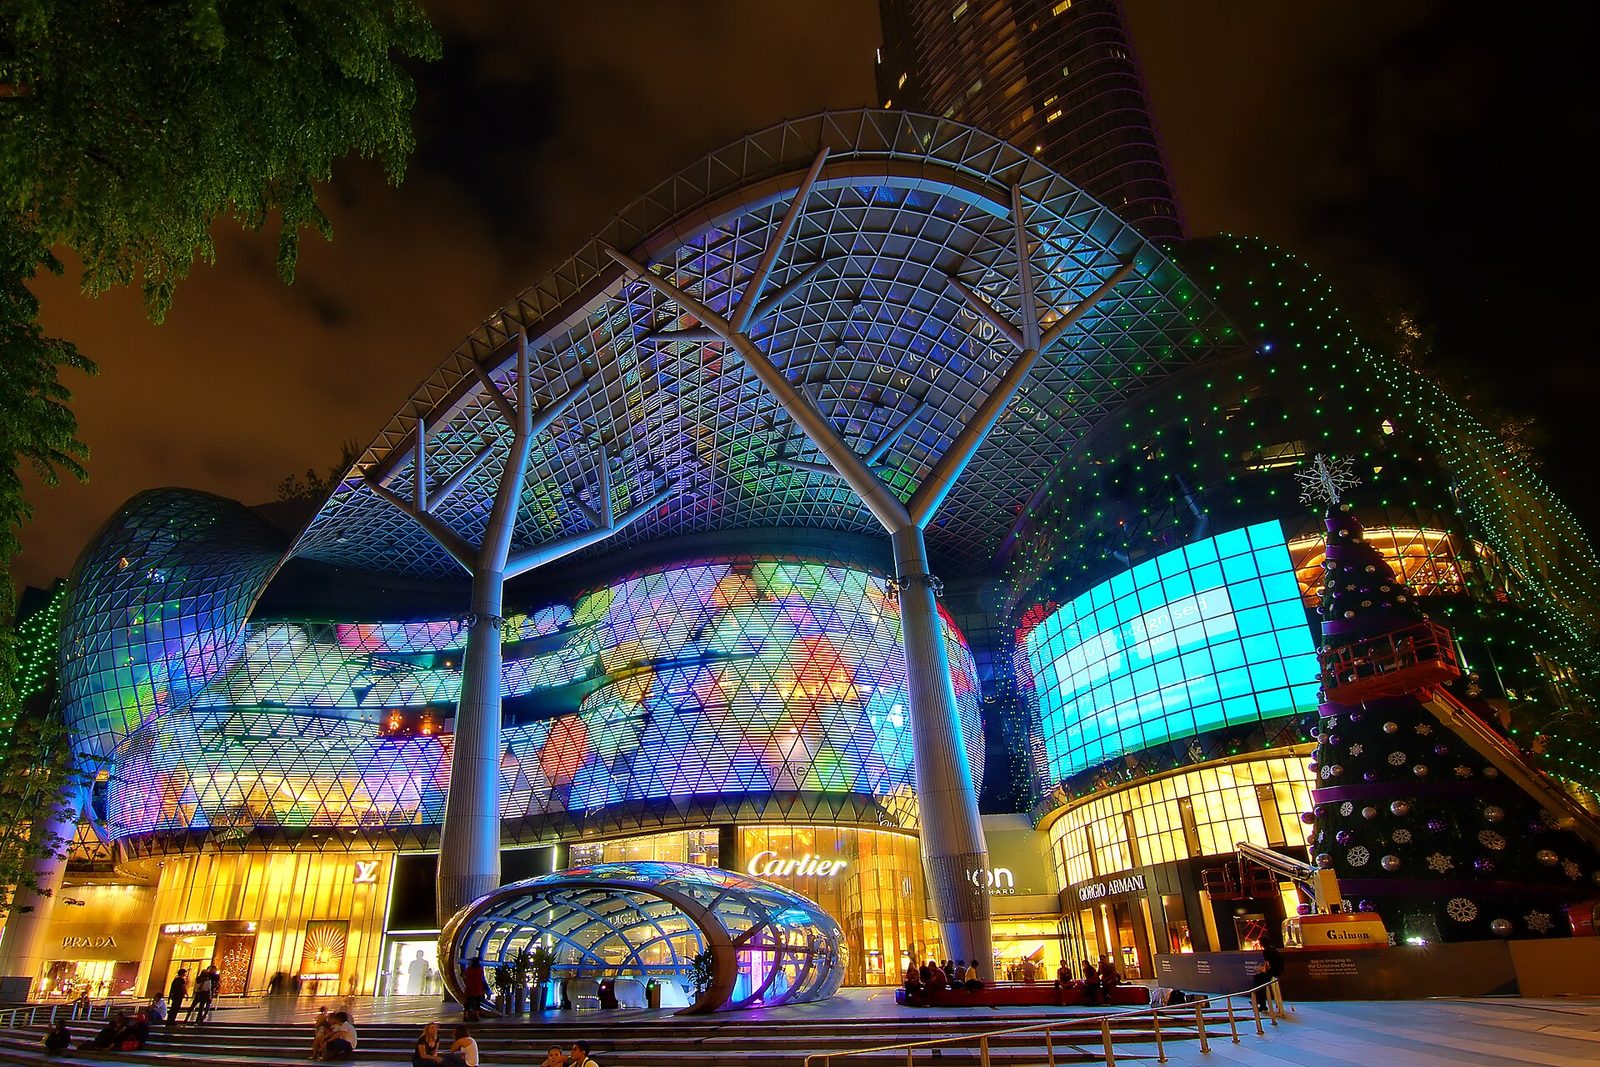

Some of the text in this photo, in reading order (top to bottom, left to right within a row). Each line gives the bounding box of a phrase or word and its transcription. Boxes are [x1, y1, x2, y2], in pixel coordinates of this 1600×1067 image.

[1115, 597, 1208, 643] recognsed
[747, 850, 848, 877] Cartier
[1078, 875, 1145, 902] GIORGIO ARMANI
[62, 936, 118, 948] PRADA
[1326, 929, 1370, 940] Galmon
